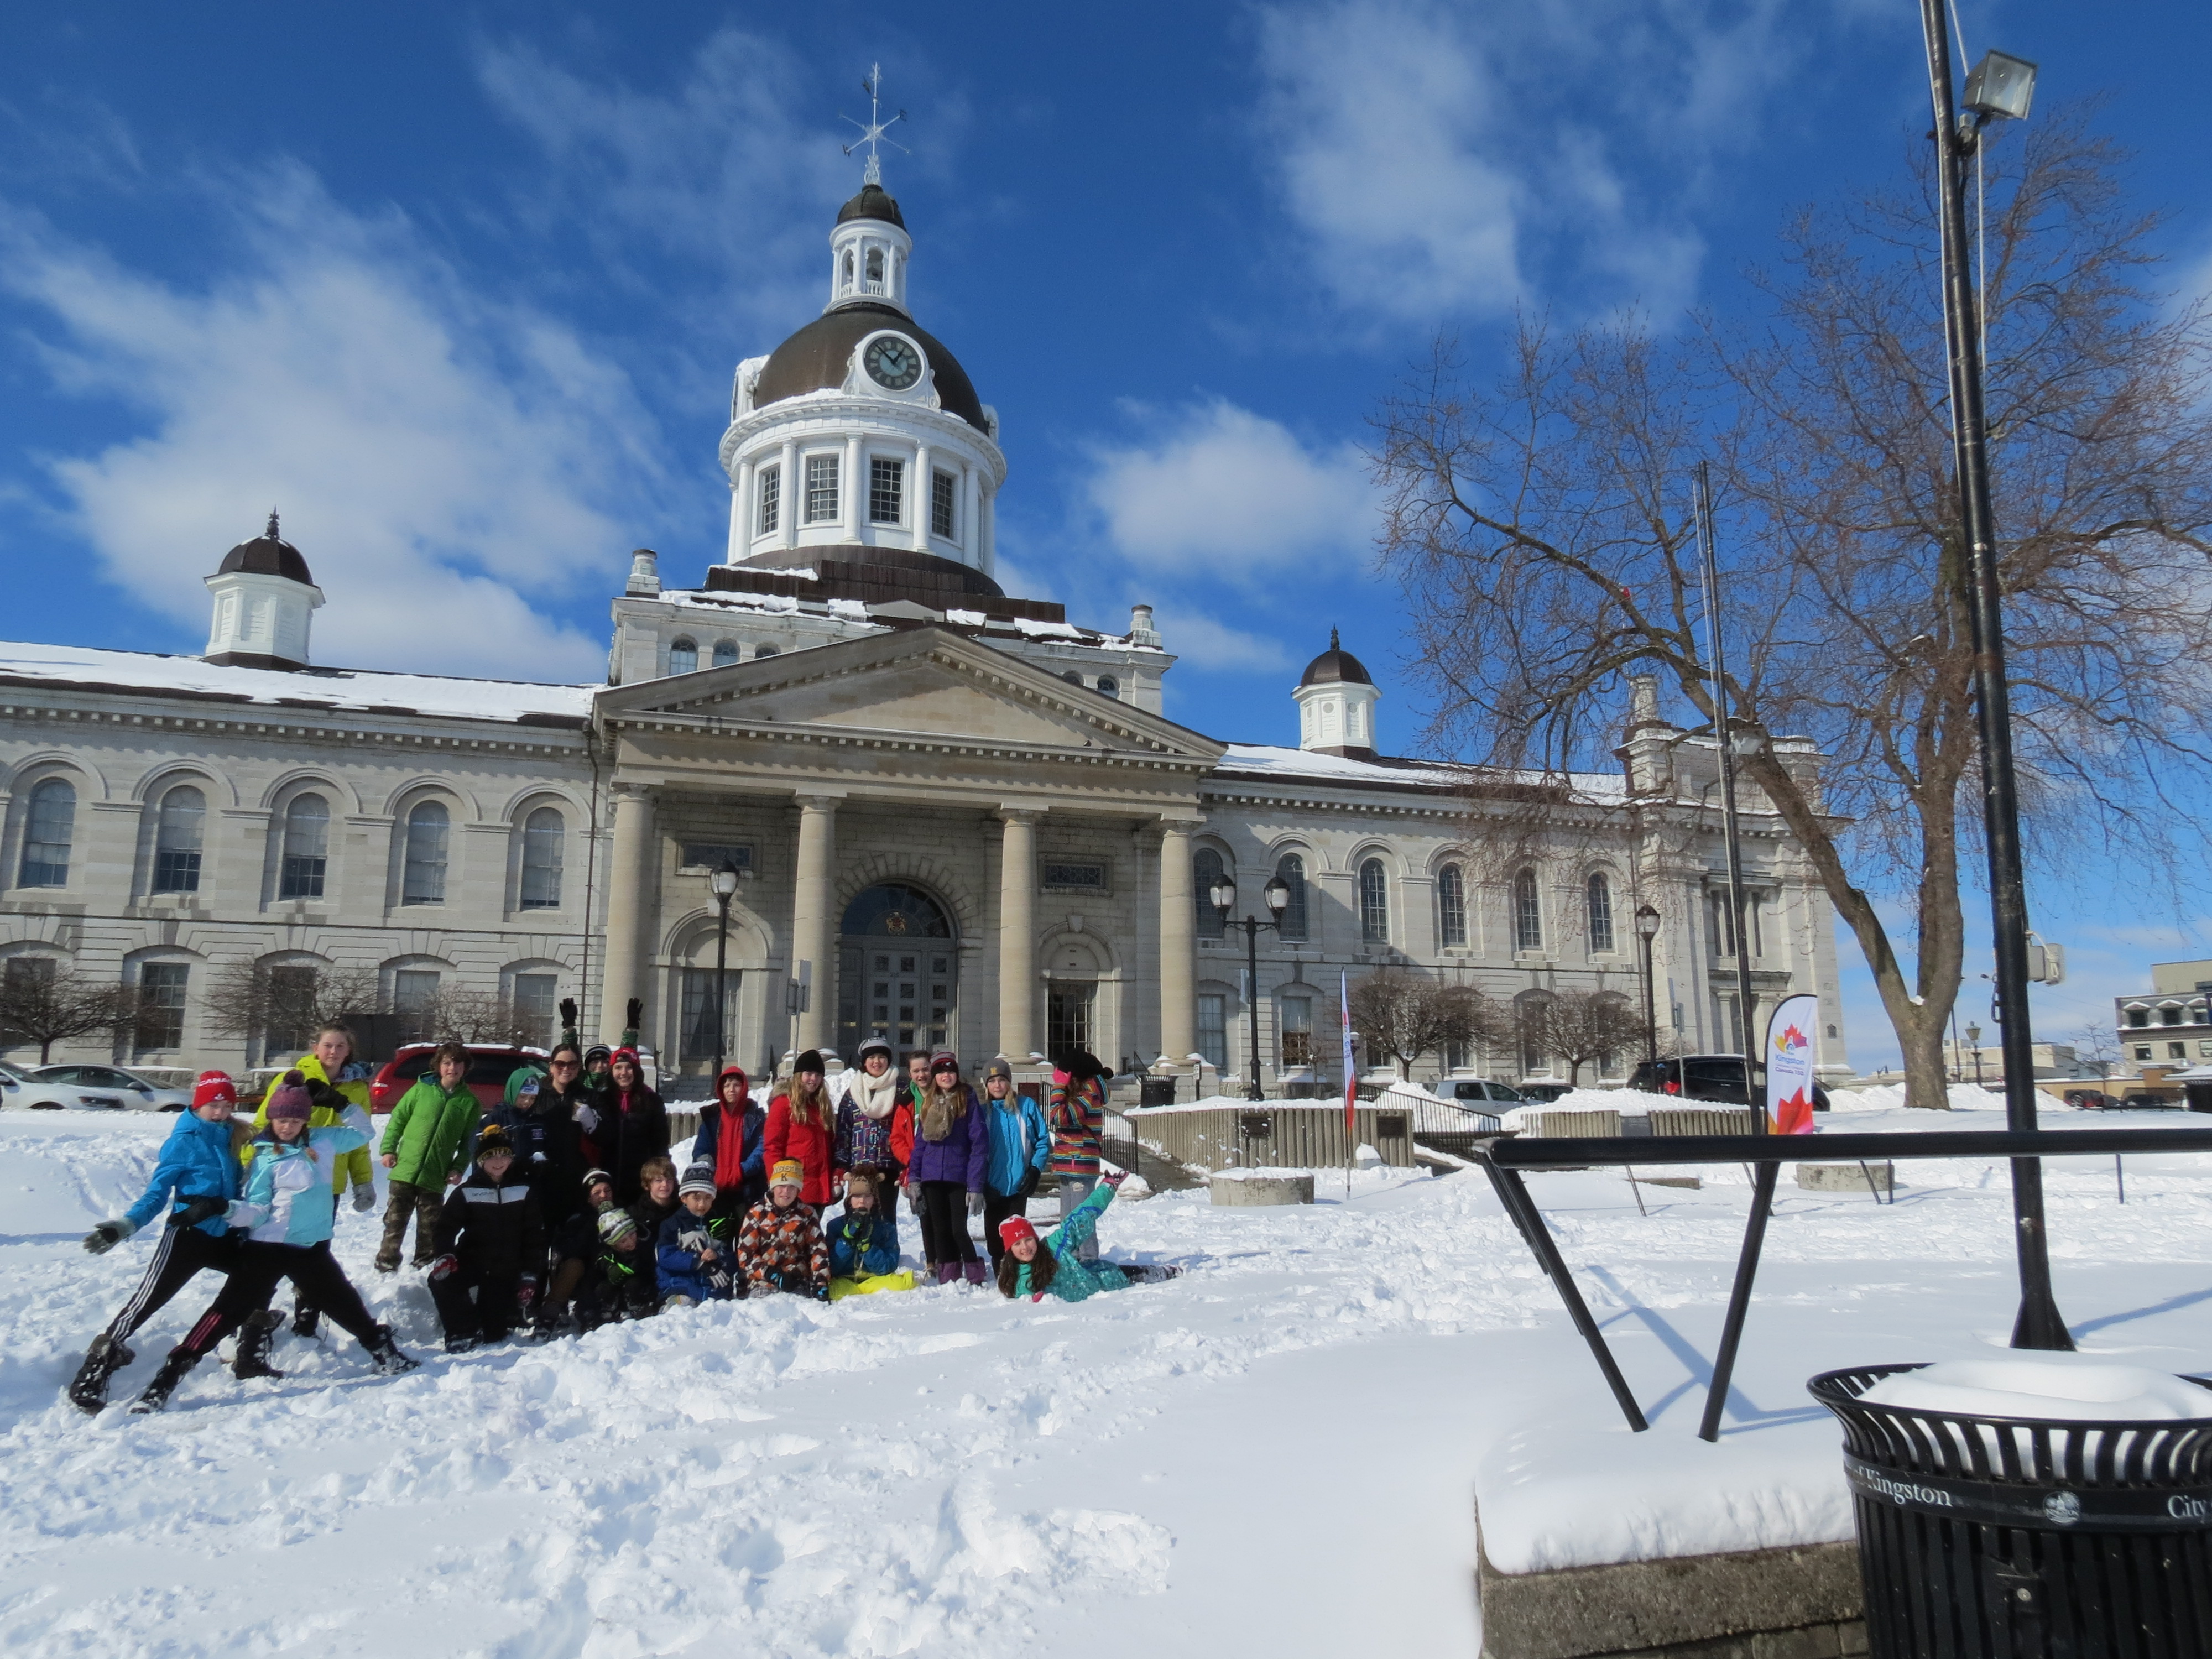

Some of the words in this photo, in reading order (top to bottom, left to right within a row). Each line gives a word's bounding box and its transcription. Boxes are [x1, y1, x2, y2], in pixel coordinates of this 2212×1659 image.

[781, 1173, 788, 1181] K
[1865, 1468, 1953, 1507] Kingston
[2168, 1495, 2207, 1524] City
